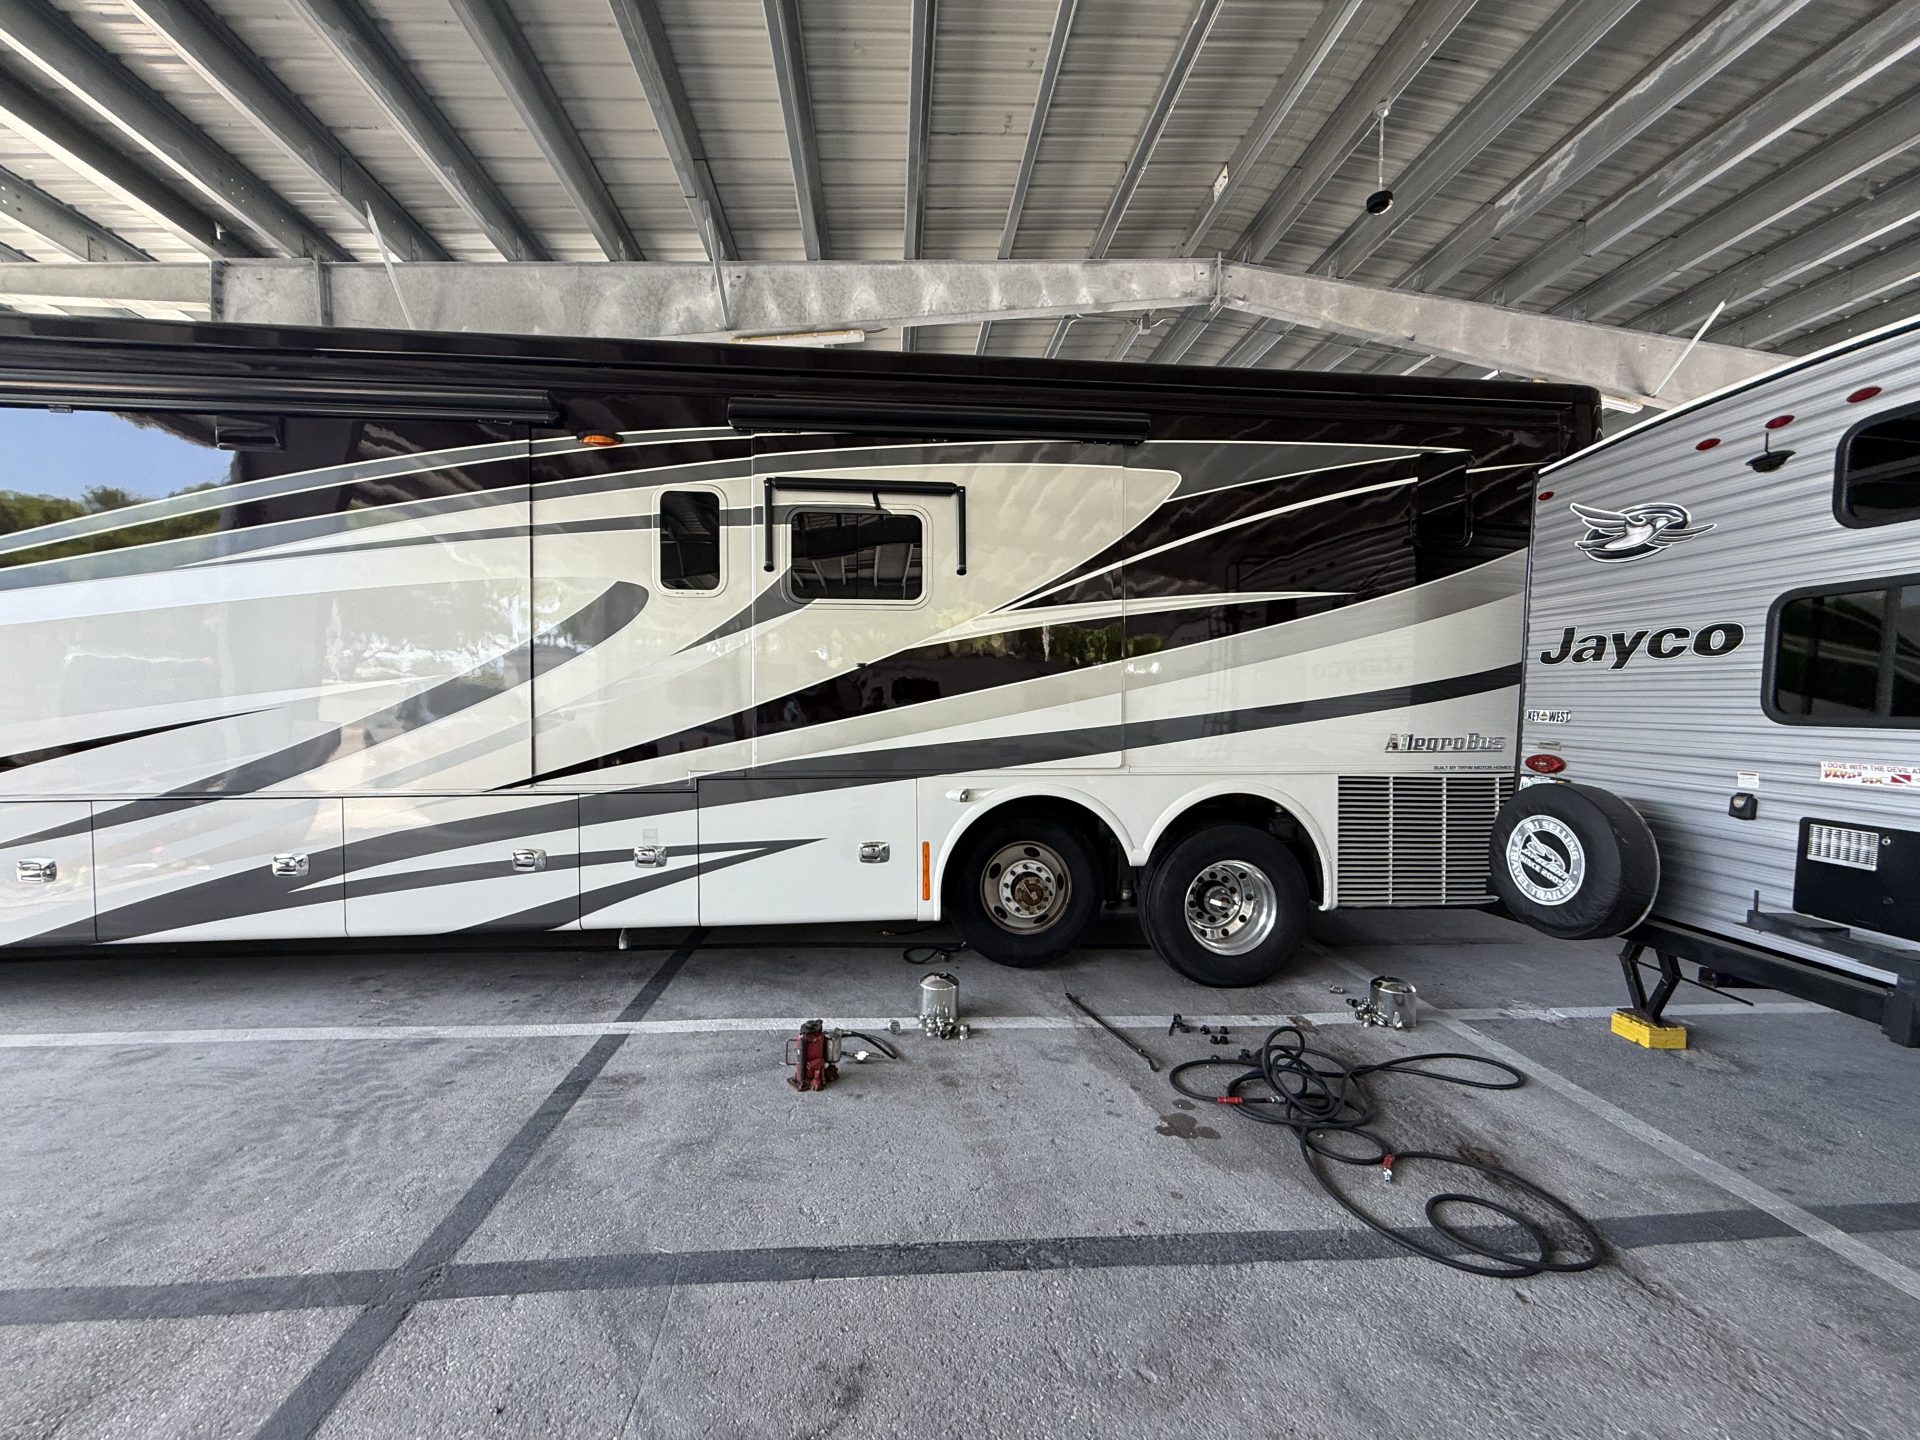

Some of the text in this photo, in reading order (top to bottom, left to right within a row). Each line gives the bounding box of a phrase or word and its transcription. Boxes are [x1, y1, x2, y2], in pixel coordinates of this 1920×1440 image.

[1538, 621, 1745, 671] Jayco
[1527, 710, 1570, 723] KEY WEST
[1849, 763, 1868, 771] WITH
[1887, 766, 1910, 774] DEVIL
[1541, 820, 1580, 860] SELLING
[1510, 845, 1577, 900] TRAVEL TRAILER
[1519, 853, 1566, 888] SINCE 2005
